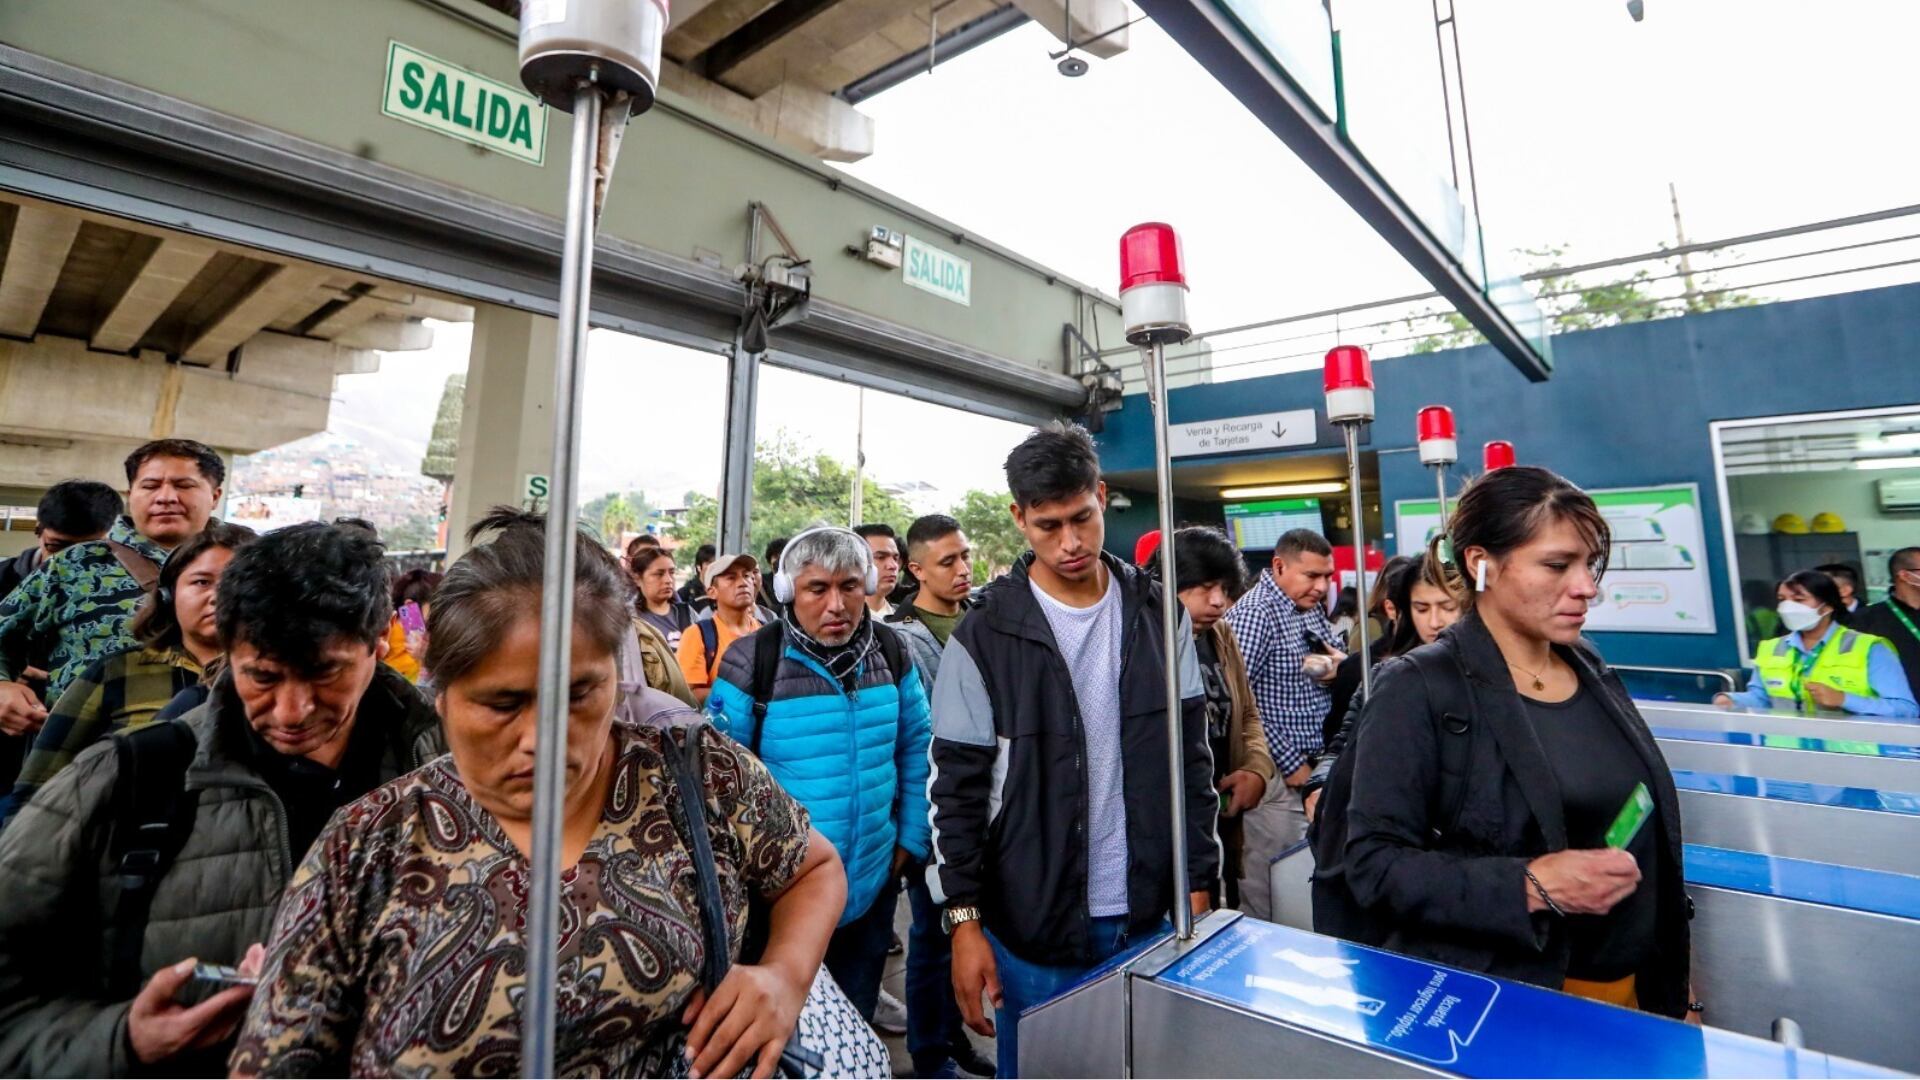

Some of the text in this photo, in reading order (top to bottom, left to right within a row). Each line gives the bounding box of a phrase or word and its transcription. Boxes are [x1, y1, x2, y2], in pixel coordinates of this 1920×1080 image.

[400, 61, 533, 150] SALIDA
[909, 247, 965, 297] SALIDA
[1185, 422, 1263, 437] Venta y Recarga
[1199, 435, 1250, 448] de Tarjetas
[529, 476, 547, 497] S
[1429, 969, 1448, 987] para
[1409, 985, 1442, 1015] ingresar
[1423, 994, 1461, 1028] Recuerda,
